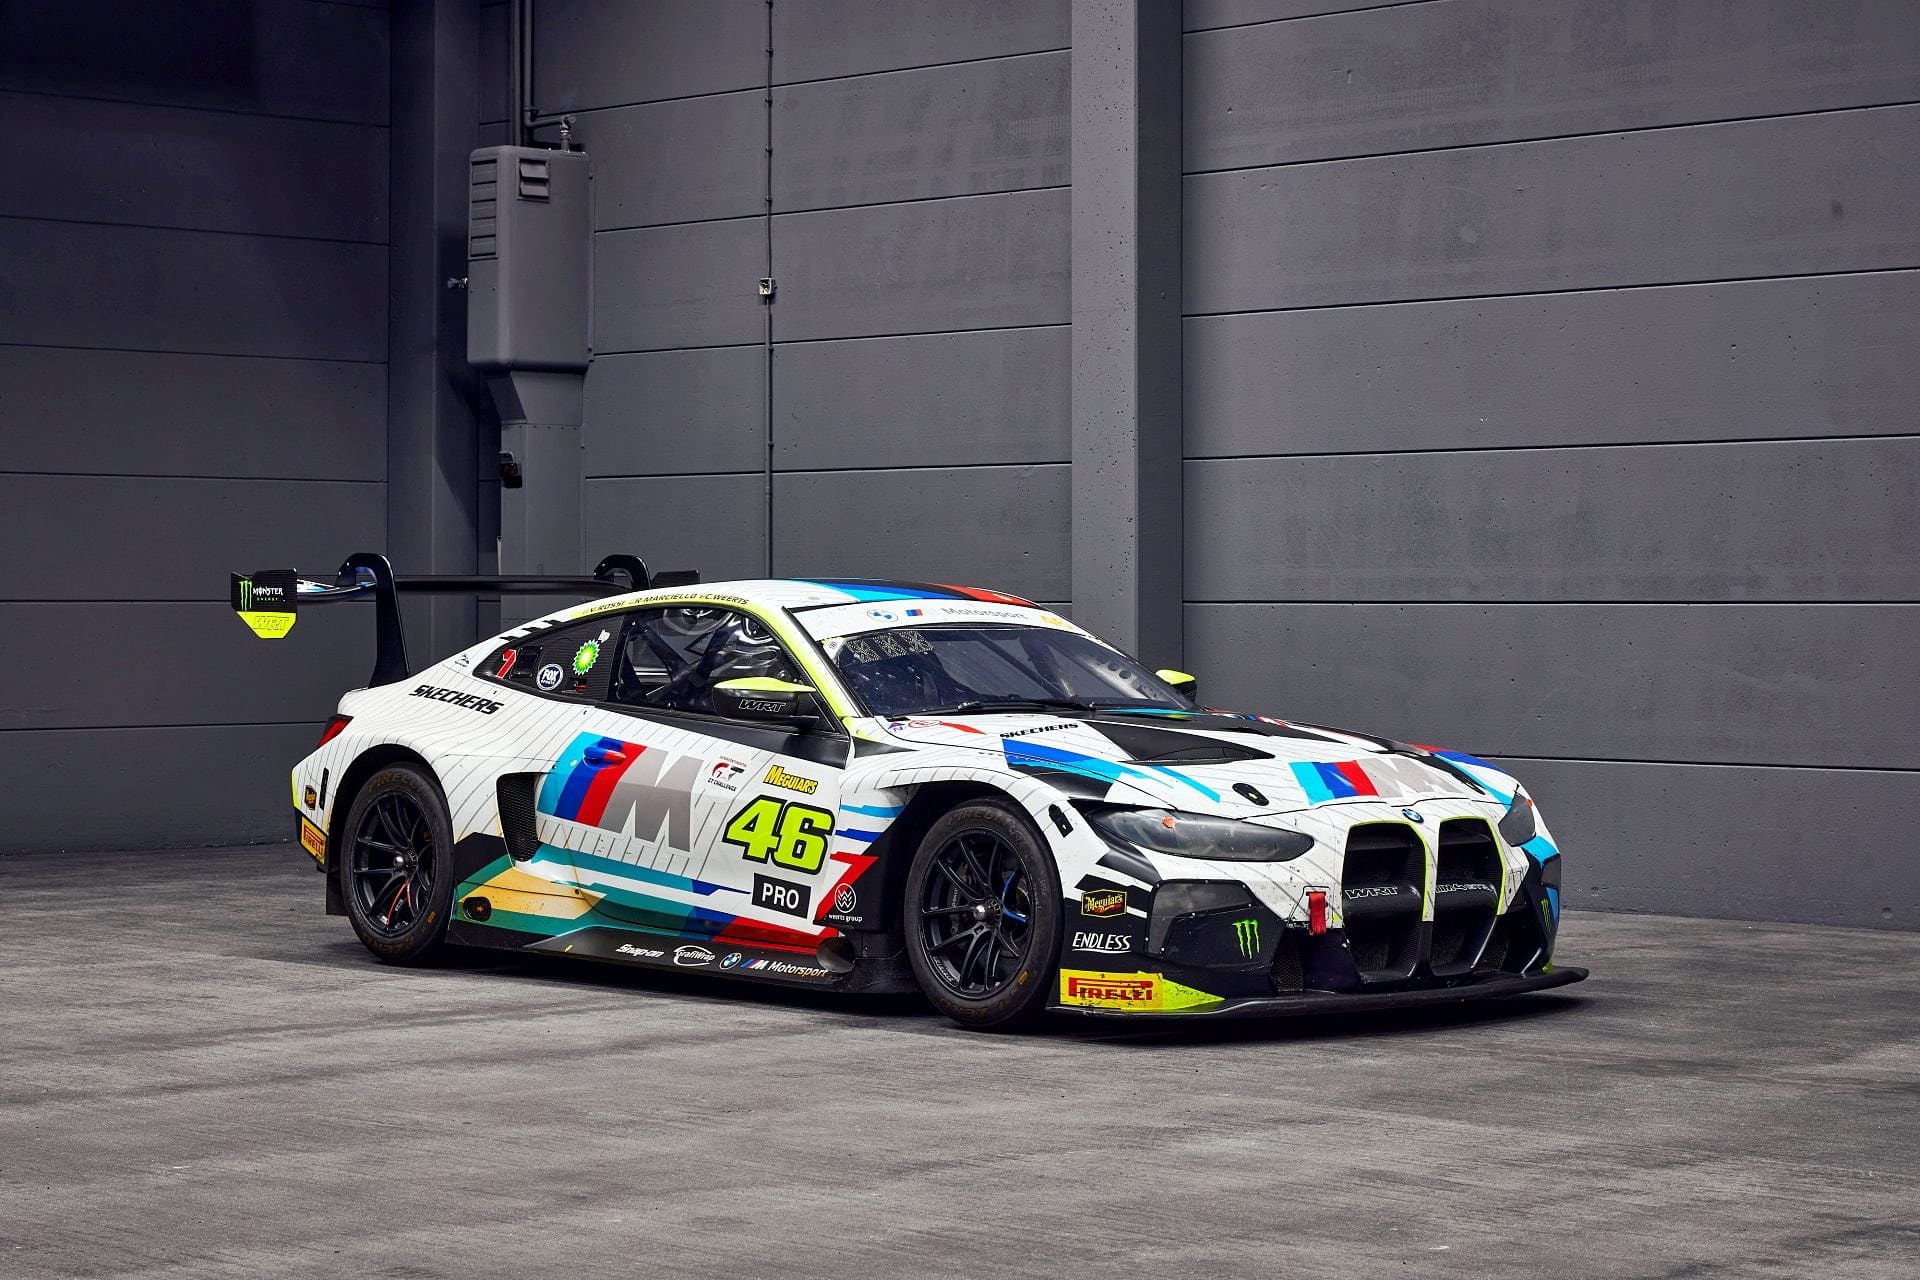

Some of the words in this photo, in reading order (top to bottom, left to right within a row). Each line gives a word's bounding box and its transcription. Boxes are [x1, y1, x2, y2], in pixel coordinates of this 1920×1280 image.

[252, 586, 284, 597] MONSTER
[941, 607, 1029, 620] Motorsport
[541, 669, 560, 682] FOX
[408, 684, 504, 715] SKECHERS
[738, 698, 787, 713] WRT
[999, 722, 1079, 739] SKECHERS
[722, 794, 836, 876] 46
[761, 882, 800, 910] PRO
[1345, 886, 1398, 900] WRT
[1085, 892, 1123, 912] Meguiar's
[1071, 931, 1133, 951] ENDLESS
[767, 961, 829, 978] Motorsport
[1068, 976, 1155, 1001] PIRELLI
